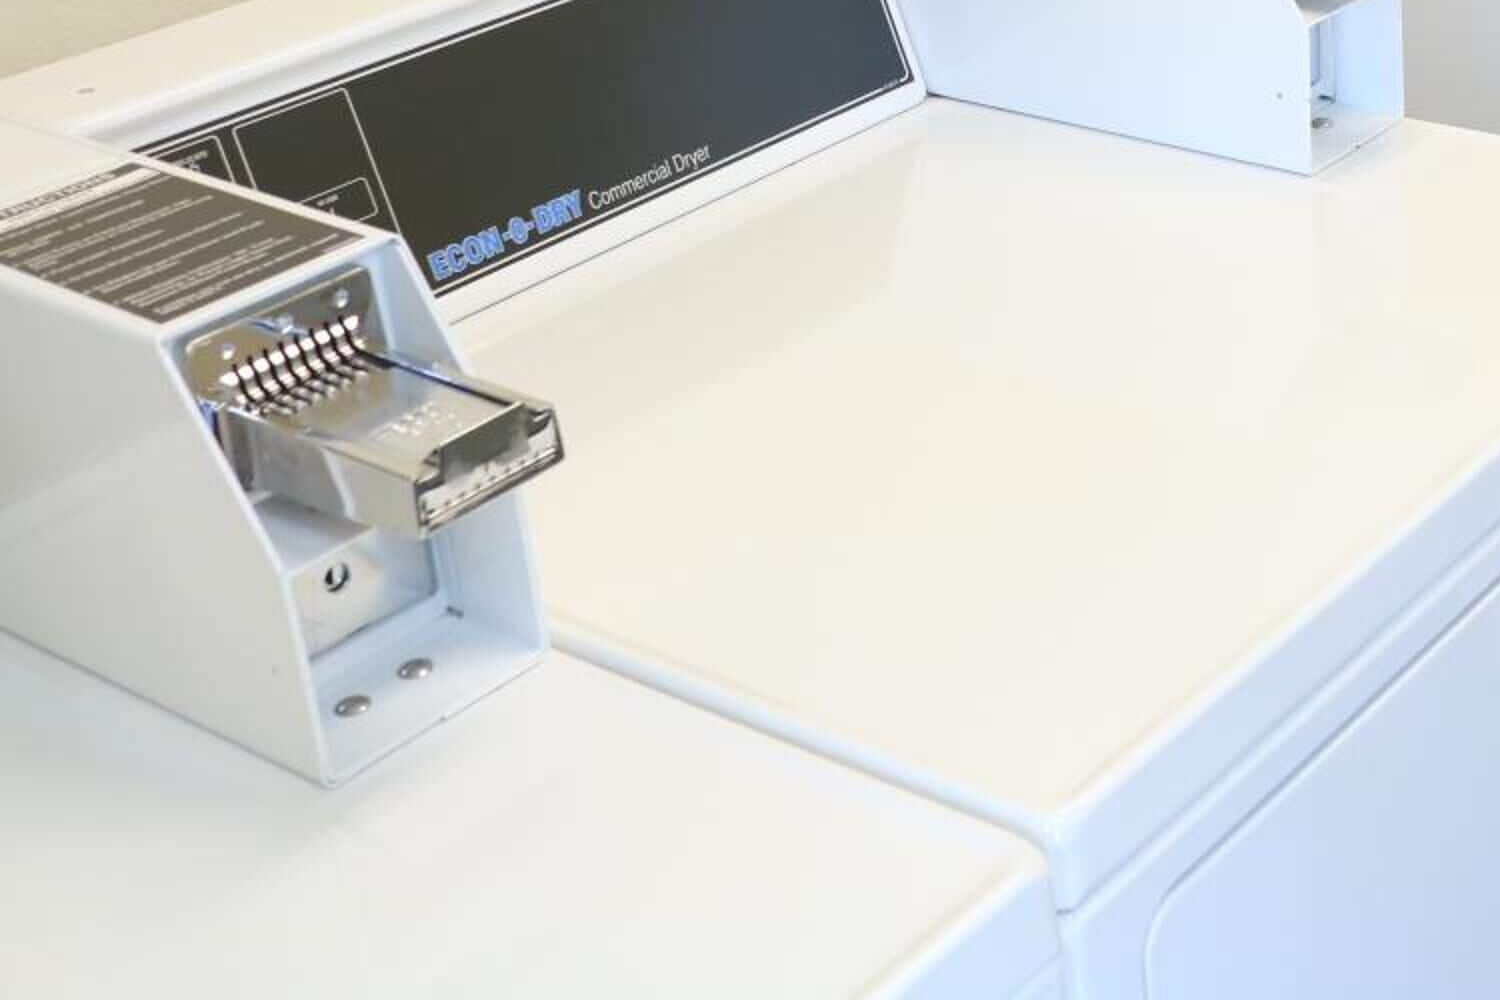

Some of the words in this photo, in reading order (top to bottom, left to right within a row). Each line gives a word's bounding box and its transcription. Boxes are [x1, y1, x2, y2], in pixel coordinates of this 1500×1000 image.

[427, 188, 584, 281] ECON-O-DRY
[588, 160, 672, 210] Commercial
[672, 144, 711, 173] Dryer
